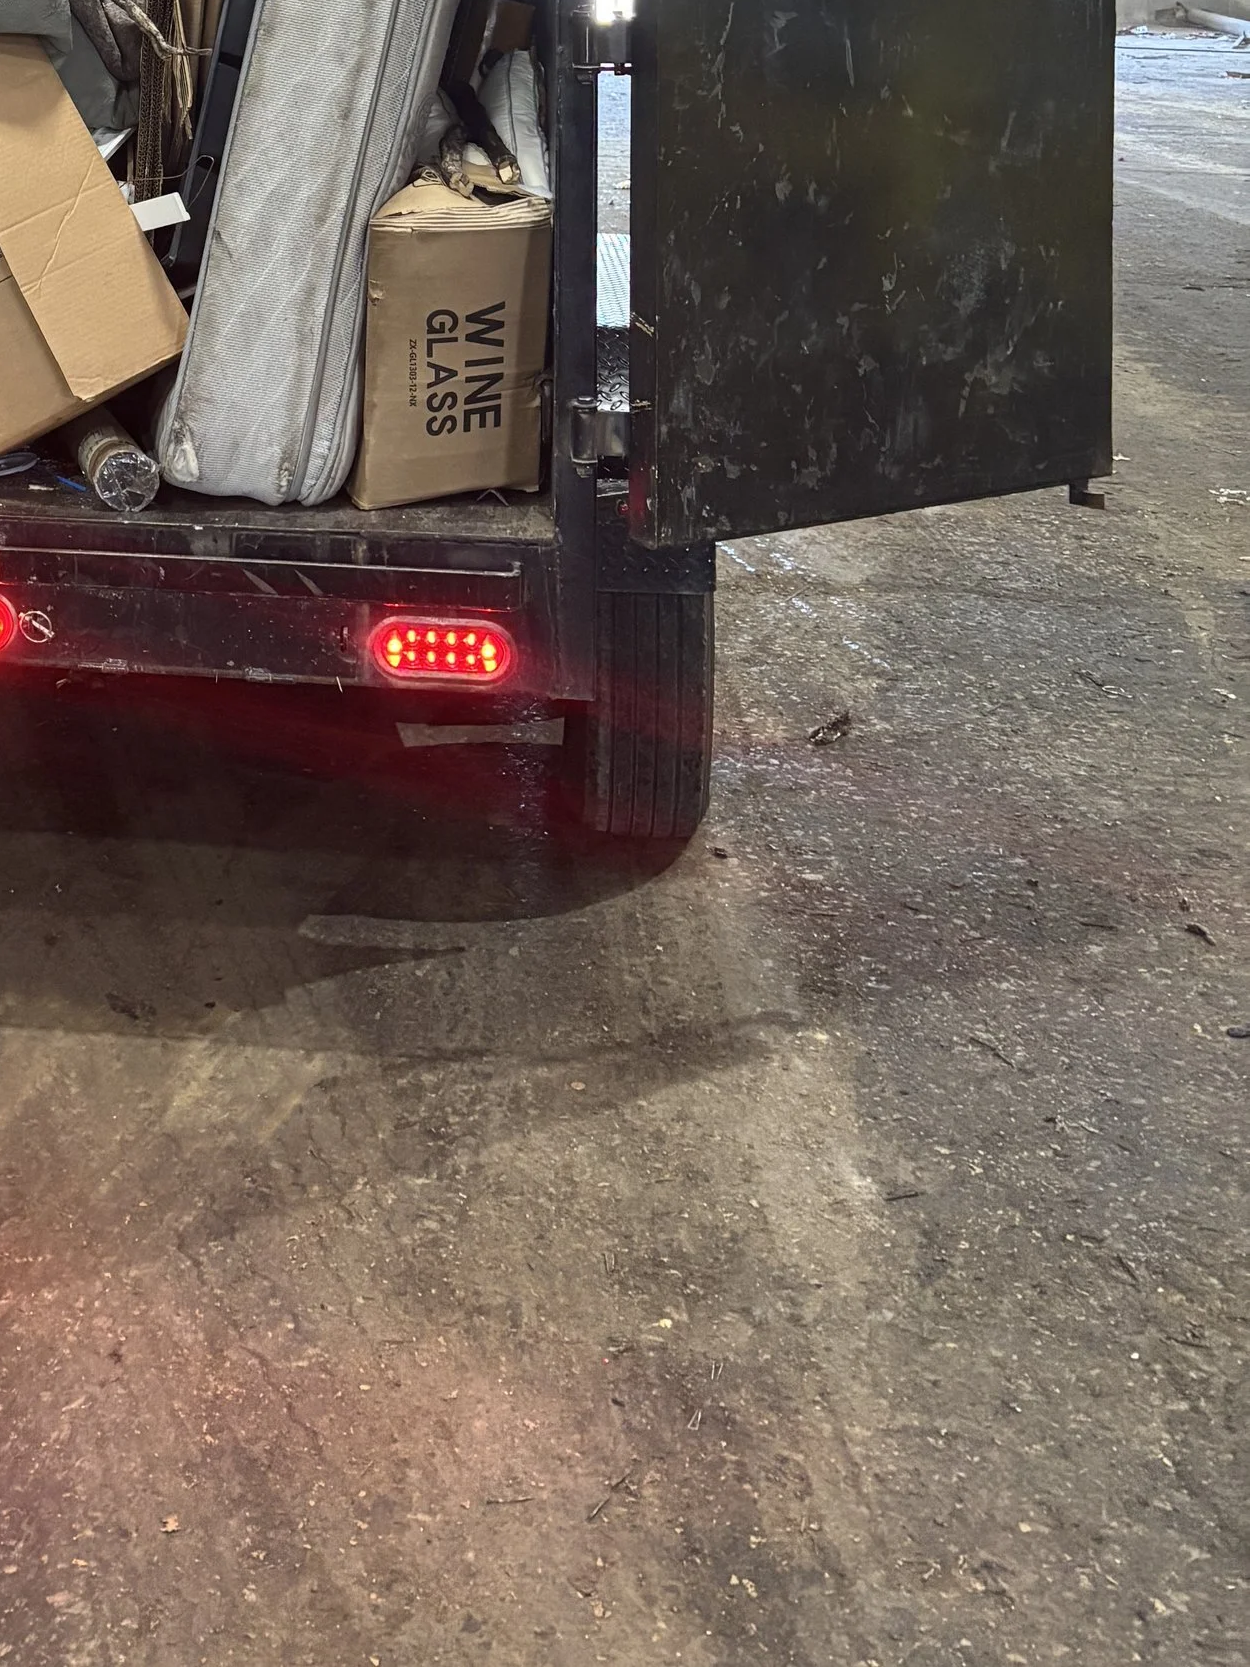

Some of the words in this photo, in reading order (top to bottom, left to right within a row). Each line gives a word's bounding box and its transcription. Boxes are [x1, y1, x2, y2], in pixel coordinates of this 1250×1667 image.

[409, 338, 417, 408] ZX-GL1303-12-NX
[426, 308, 458, 436] GLASS
[463, 300, 506, 433] WINE
